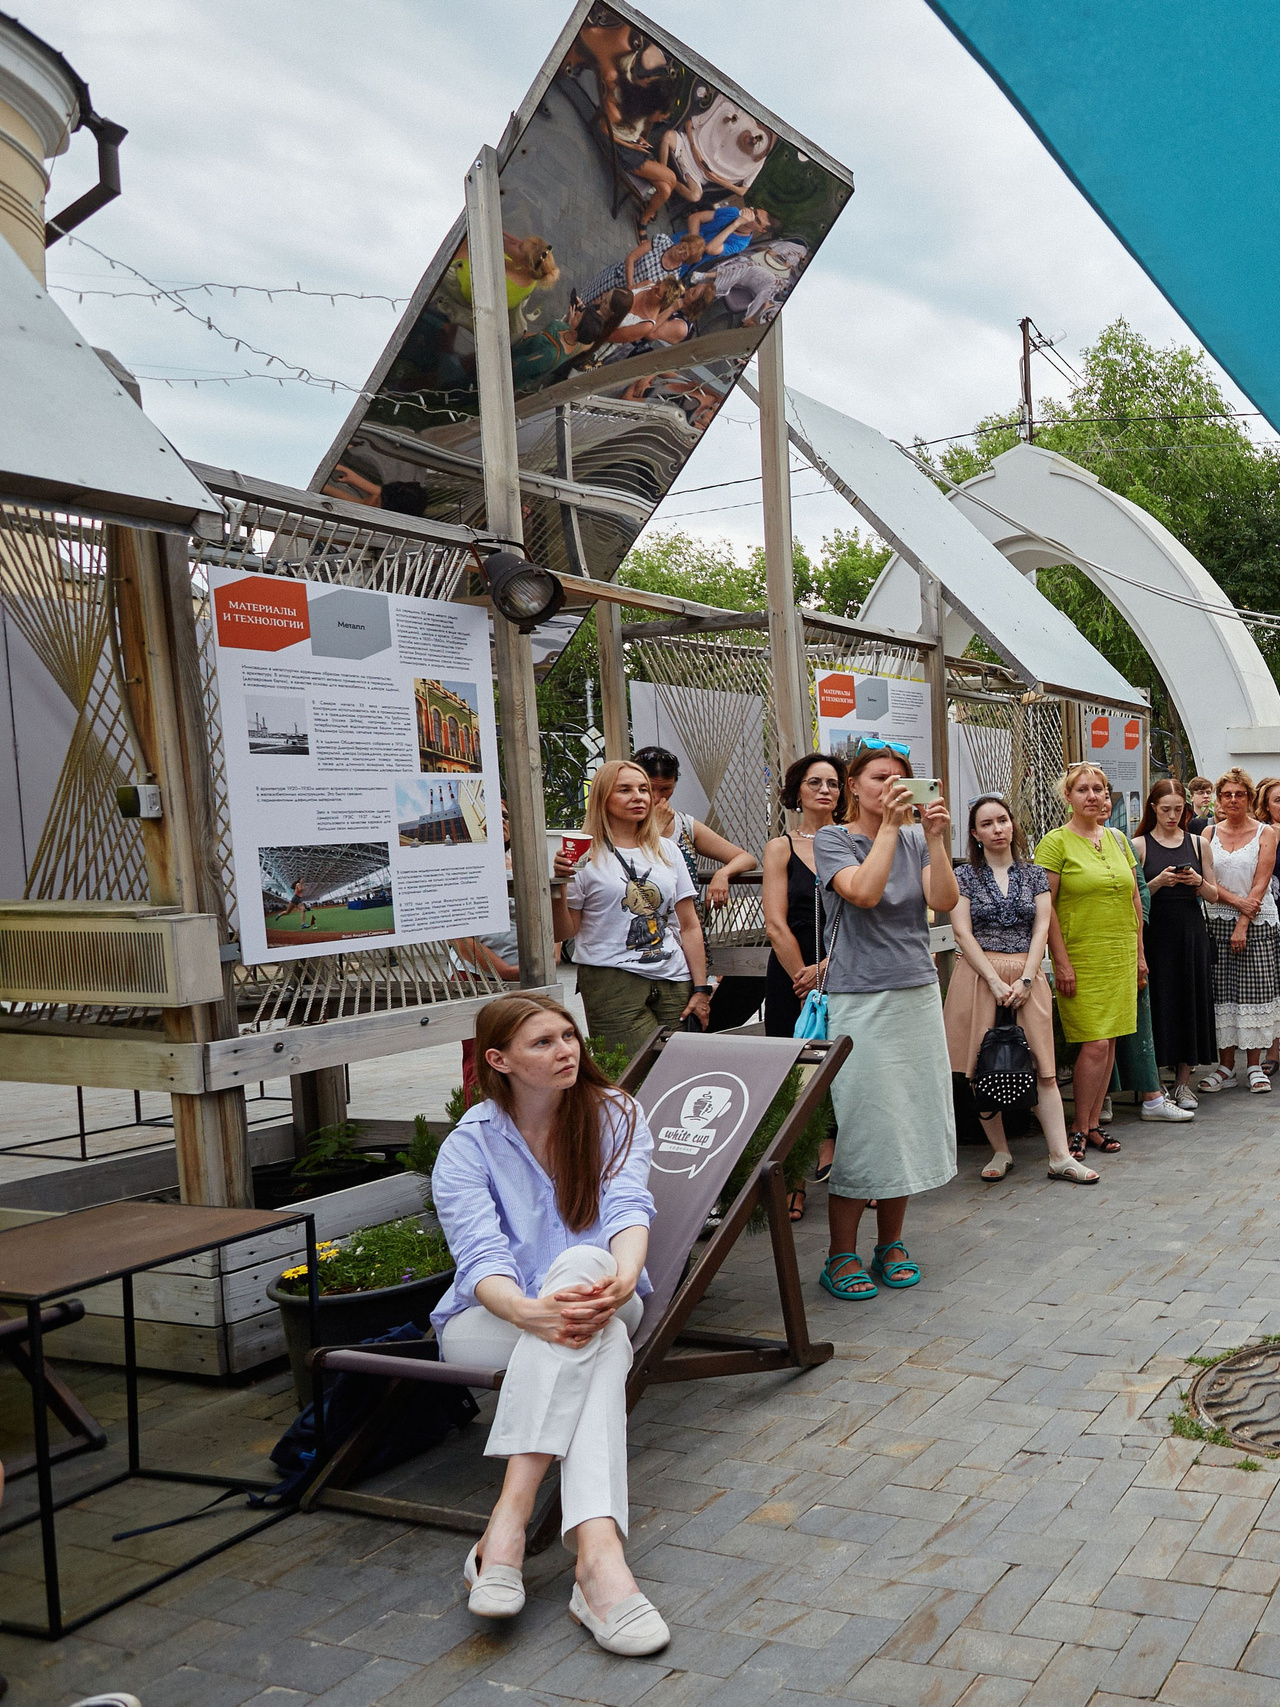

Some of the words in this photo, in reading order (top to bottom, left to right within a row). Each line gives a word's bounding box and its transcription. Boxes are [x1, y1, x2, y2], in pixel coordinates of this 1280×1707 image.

[229, 600, 297, 617] МАТЕРИАЛЫ
[222, 612, 232, 621] И
[233, 613, 304, 630] ТЕХНОЛОГИИ
[337, 621, 366, 631] Металл
[823, 688, 851, 697] МАТЕРИАЛЫ
[825, 696, 854, 704] ТЕХНОЛОГИИ
[664, 1129, 691, 1142] white
[692, 1134, 710, 1146] cup
